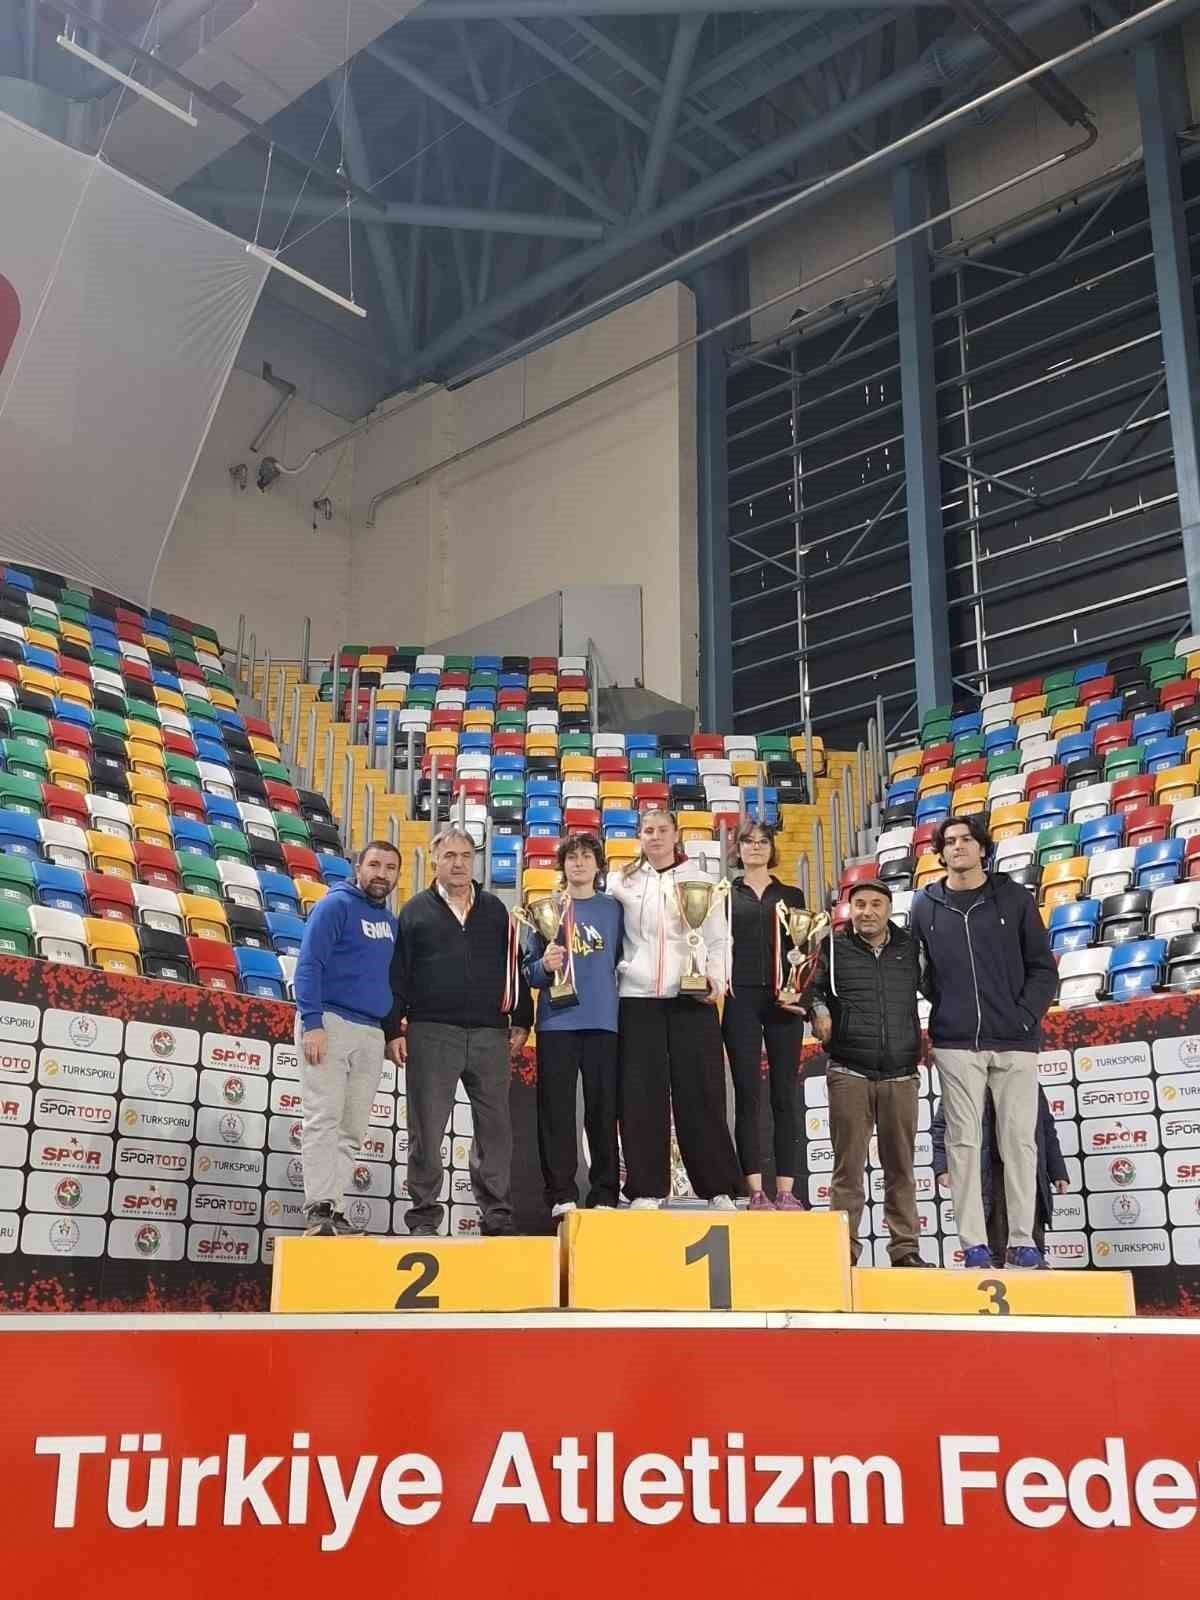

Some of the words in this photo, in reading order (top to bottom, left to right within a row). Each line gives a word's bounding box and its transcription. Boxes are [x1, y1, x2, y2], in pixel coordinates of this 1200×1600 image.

[211, 1048, 261, 1066] SPOR
[1096, 1054, 1146, 1067] TURKSPORU
[62, 1064, 115, 1079] TURKSPORU
[141, 1114, 190, 1128] TURKSPORU
[1092, 1130, 1147, 1146] SPOR
[41, 1146, 101, 1165] SPOR
[213, 1160, 260, 1173] TURKSPORU
[123, 1195, 177, 1211] SPOR
[198, 1239, 249, 1255] SPOR
[1112, 1243, 1166, 1254] TURKSPORU
[685, 1225, 732, 1311] 1
[395, 1252, 440, 1309] 2
[977, 1280, 1010, 1316] 3
[35, 1432, 443, 1552] Türkiye
[471, 1431, 905, 1526] Atletizm
[938, 1435, 1200, 1529] Fede
